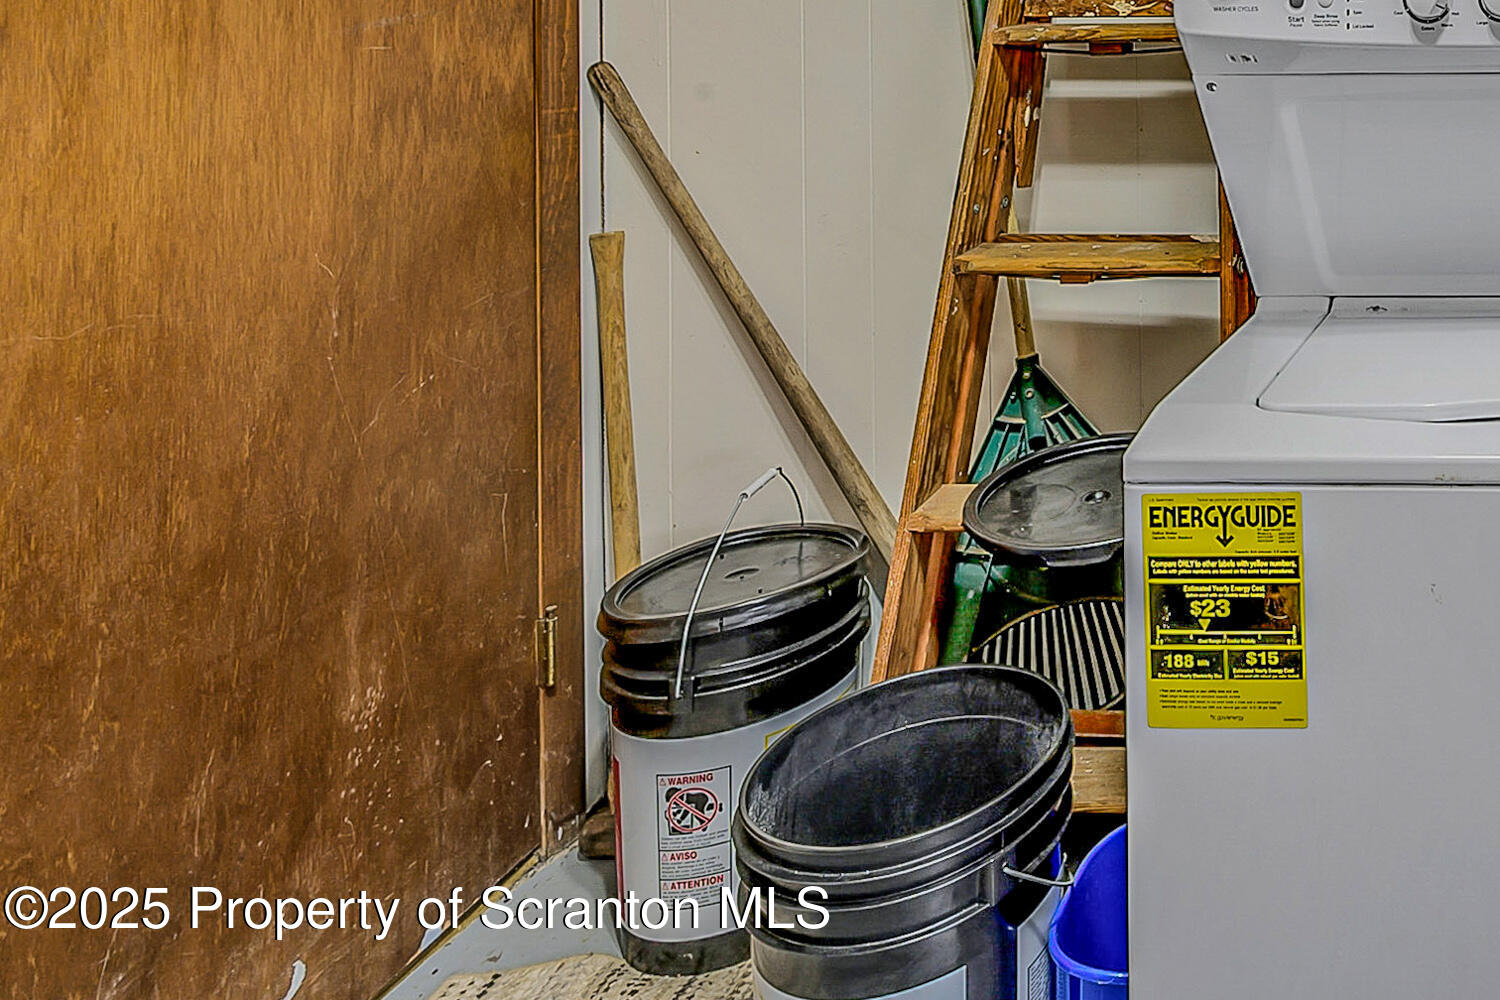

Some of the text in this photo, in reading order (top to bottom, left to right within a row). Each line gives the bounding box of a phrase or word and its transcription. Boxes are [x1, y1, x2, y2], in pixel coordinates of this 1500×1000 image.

[1149, 505, 1296, 528] ENERGYGUIDE
[1150, 559, 1177, 569] Compare
[1178, 559, 1195, 568] ONLY
[1202, 560, 1217, 568] other
[1218, 559, 1235, 568] labels
[1236, 559, 1250, 568] with
[1250, 559, 1269, 570] yellow
[1183, 584, 1266, 594] Estimated Yearly Energy Cost
[1190, 599, 1231, 618] $23
[1164, 654, 1195, 668] 188
[1246, 651, 1279, 666] $15
[668, 773, 713, 786] WARNING
[670, 851, 697, 862] AVISO
[671, 875, 724, 891] ATTENTION
